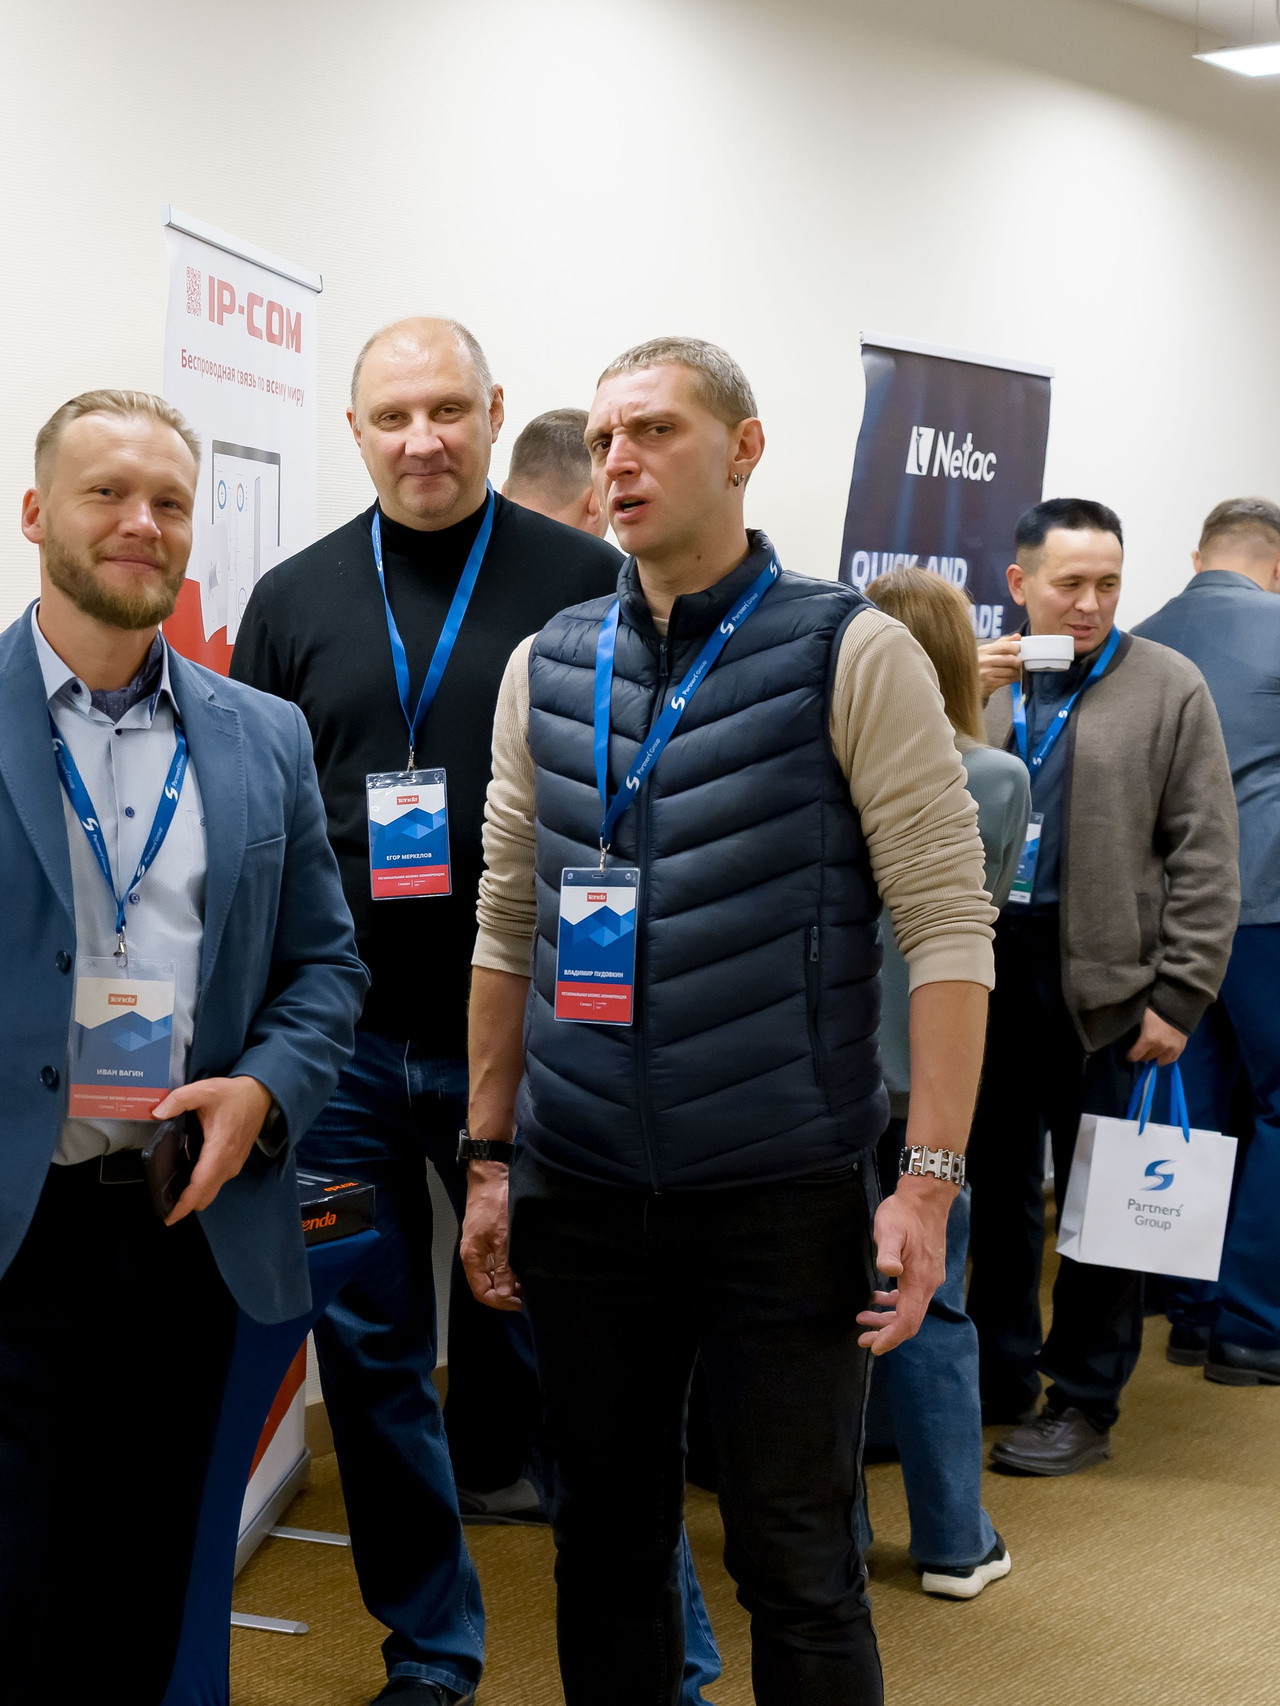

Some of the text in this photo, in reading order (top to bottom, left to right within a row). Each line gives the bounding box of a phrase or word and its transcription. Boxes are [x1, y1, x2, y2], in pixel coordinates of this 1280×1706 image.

[208, 275, 302, 354] IP-COM
[181, 348, 305, 407] Беспроводная связь по всему миру
[932, 431, 997, 483] Netac
[401, 852, 432, 860] МЕРКЕЛОВ
[563, 969, 594, 977] ВЛАДИМИР
[96, 1068, 144, 1077] ИВАН ВАГИН
[302, 1211, 337, 1232] enda
[1134, 1215, 1172, 1231] Group
